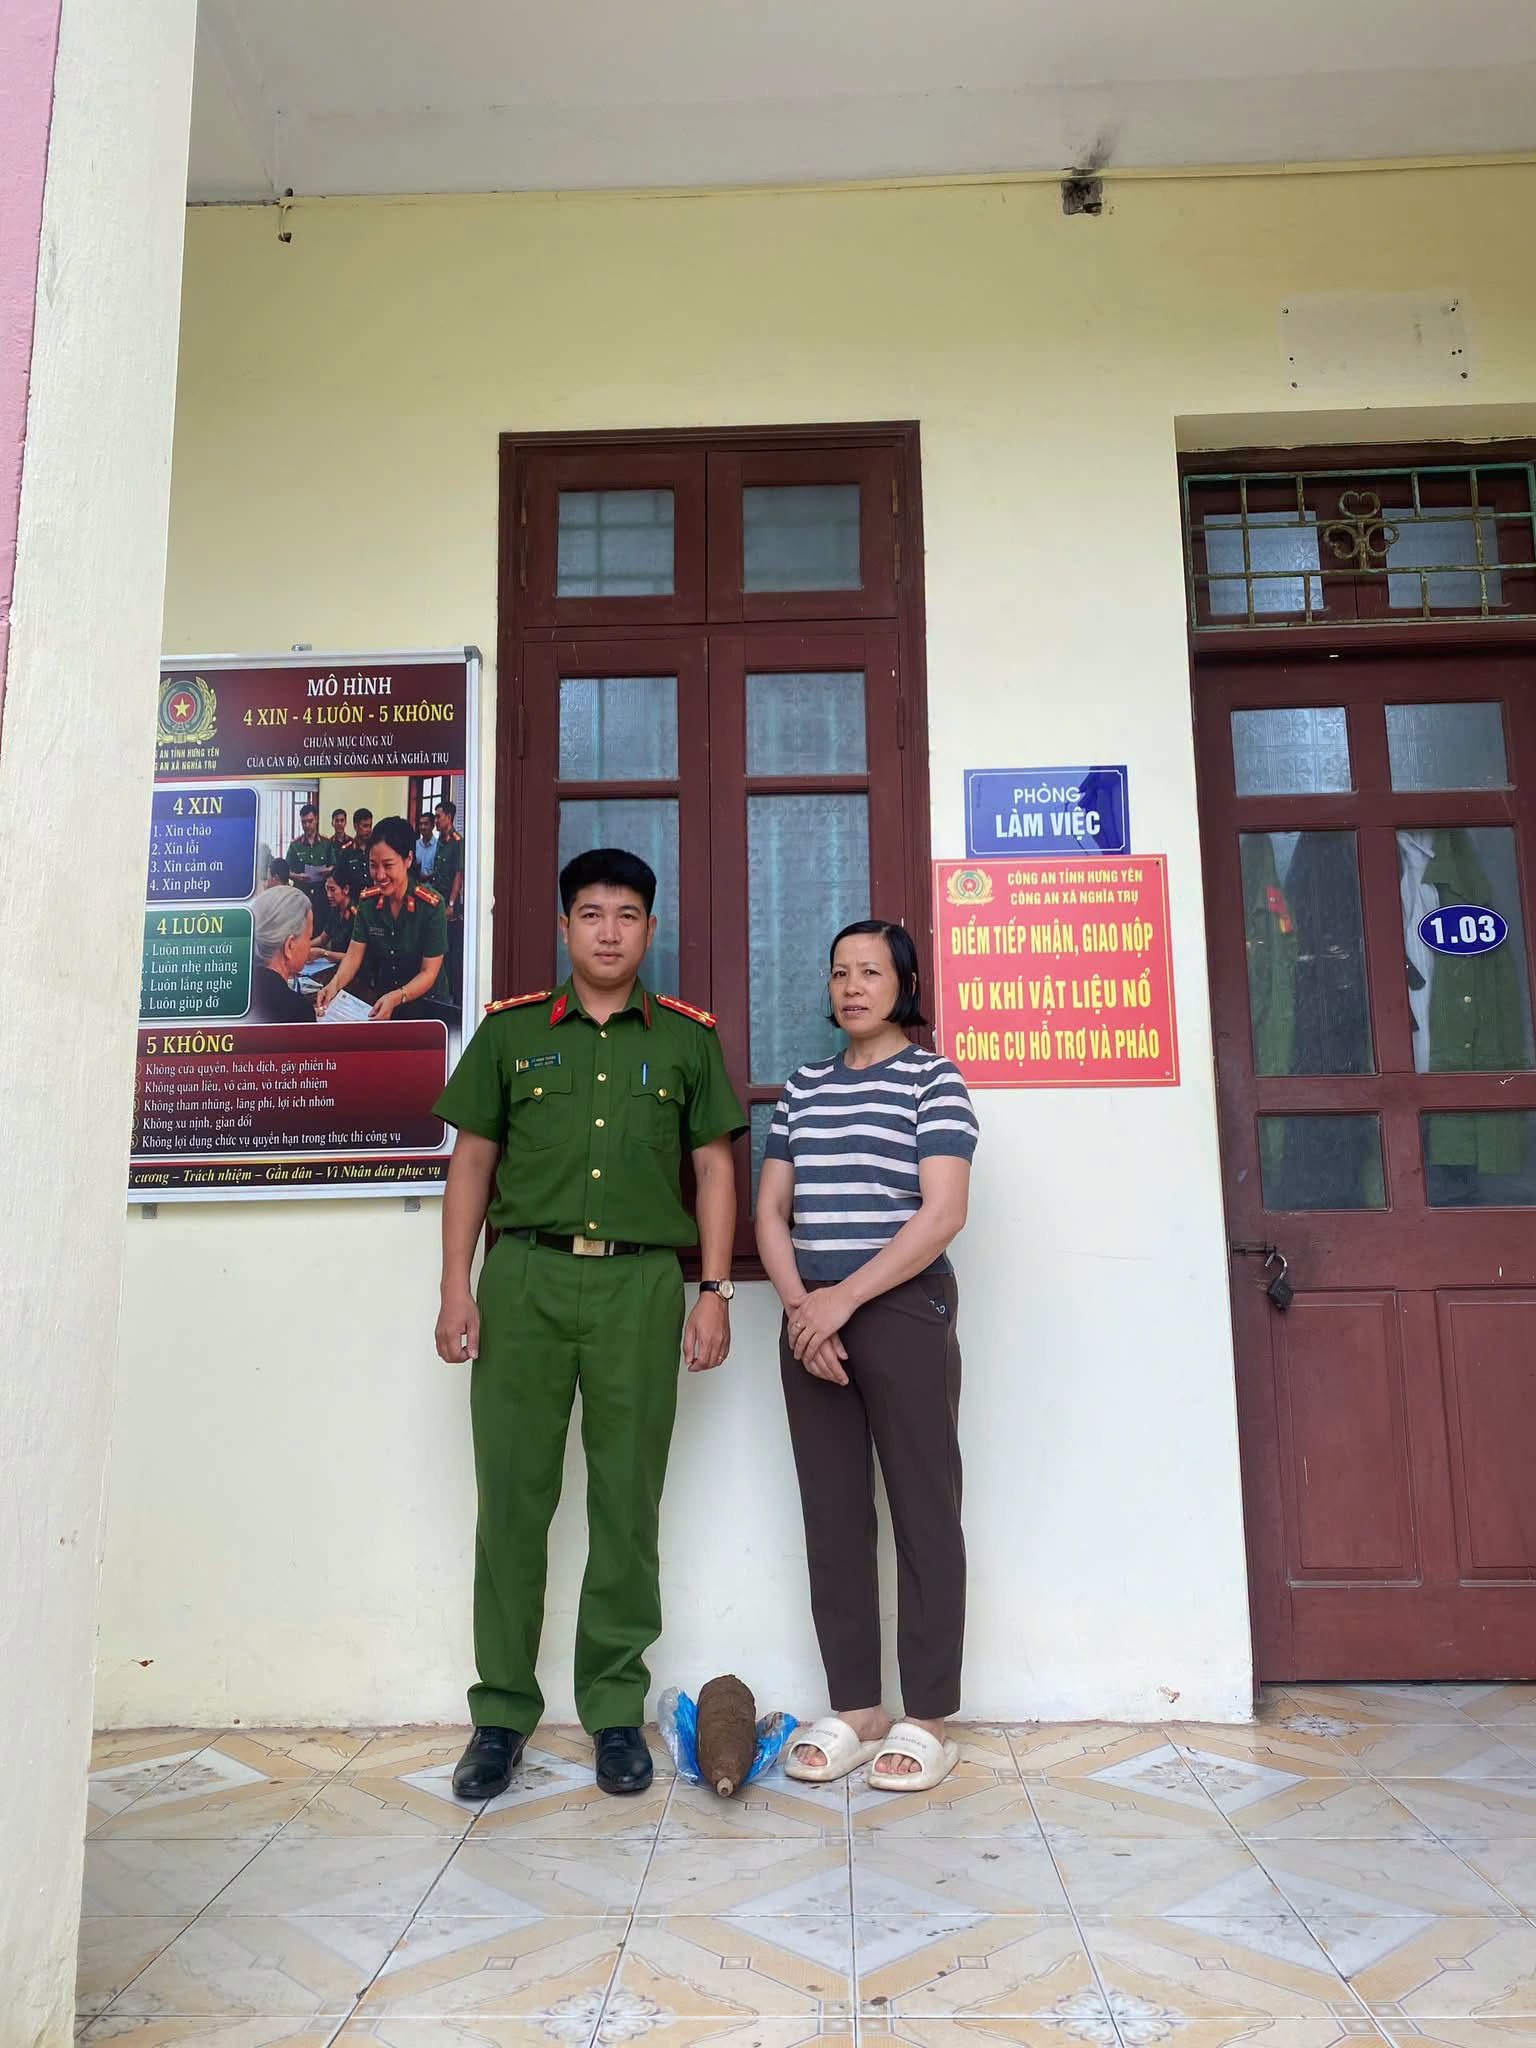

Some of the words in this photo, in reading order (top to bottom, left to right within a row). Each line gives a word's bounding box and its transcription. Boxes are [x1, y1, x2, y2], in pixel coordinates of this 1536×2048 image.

[307, 673, 338, 696] MÔ
[343, 672, 391, 695] HÌNH
[243, 709, 252, 725] 4
[257, 708, 288, 725] XIN
[303, 707, 312, 724] 4
[317, 701, 364, 724] LUÔN
[379, 705, 388, 722] 5
[393, 699, 455, 722] KHÔNG
[344, 751, 369, 765] CÔNG
[371, 754, 384, 765] AN
[431, 752, 449, 765] TRỤ
[1013, 782, 1081, 804] PHÒNG
[173, 798, 183, 815] 4
[188, 796, 223, 815] XIN
[153, 825, 162, 837] 1.
[165, 824, 183, 837] Xin
[186, 823, 212, 836] chào
[995, 808, 1044, 838] LÀM
[1050, 806, 1101, 840] VIỆC
[151, 843, 161, 855] 2.
[164, 842, 182, 855] Xin
[150, 861, 160, 873] 3.
[163, 860, 181, 873] Xin
[209, 860, 223, 871] ơn
[162, 878, 180, 891] Xin
[184, 877, 211, 893] phép
[1007, 870, 1038, 885] CÔNG
[1041, 872, 1056, 884] AN
[1121, 867, 1143, 883] YÊN
[1010, 890, 1041, 905] CÔNG
[1044, 892, 1059, 905] AN
[1062, 889, 1077, 904] XÃ
[1117, 889, 1139, 905] TRỤ
[156, 917, 167, 935] 4
[172, 912, 224, 935] LUÔN
[1430, 915, 1496, 944] 1.03
[951, 914, 990, 956] ĐIỂM
[994, 916, 1027, 955] TIẾP
[1030, 918, 1079, 960] NHẬN,
[1082, 923, 1118, 953] GIAO
[1121, 916, 1154, 958] NỘP
[152, 943, 179, 956] Luôn
[151, 961, 178, 974] Luôn
[181, 960, 201, 975] nhẹ
[204, 959, 238, 975] nhàng
[150, 979, 177, 992] Luôn
[180, 976, 203, 993] lắng
[206, 977, 232, 993] nghe
[958, 976, 984, 1011] VŨ
[989, 975, 1024, 1010] KHÍ
[1028, 975, 1066, 1015] VẬT
[1071, 973, 1117, 1015] LIỆU
[1122, 967, 1151, 1008] NỔ
[149, 997, 176, 1010] Luôn
[179, 996, 203, 1012] giúp
[146, 1036, 157, 1054] 5
[162, 1030, 235, 1054] KHÔNG
[955, 1026, 1001, 1062] CÔNG
[1004, 1031, 1026, 1068] CỤ
[1029, 1020, 1051, 1061] HỖ
[1055, 1027, 1086, 1066] TRỢ
[1089, 1023, 1112, 1060] VÀ
[1115, 1023, 1160, 1059] PHÁO
[145, 1063, 176, 1077] Không
[145, 1081, 175, 1095] Không
[177, 1083, 199, 1095] quan
[224, 1080, 235, 1091] vô
[261, 1079, 273, 1090] vô
[275, 1077, 297, 1089] trách
[300, 1077, 328, 1091] nhiệm
[144, 1099, 174, 1113] Không
[176, 1098, 199, 1111] tham
[236, 1097, 256, 1111] lãng
[278, 1096, 289, 1110] lợi
[292, 1095, 306, 1107] ích
[308, 1095, 335, 1108] nhóm
[143, 1117, 173, 1131] Không
[175, 1119, 186, 1129] xu
[215, 1115, 235, 1131] gian
[142, 1135, 172, 1150] Không
[174, 1135, 187, 1149] lợi
[189, 1134, 213, 1149] dụng
[215, 1133, 237, 1146] chức
[239, 1136, 250, 1148] vụ
[252, 1131, 280, 1148] quyền
[282, 1132, 299, 1146] hạn
[301, 1133, 326, 1145] trong
[328, 1130, 348, 1145] thực
[350, 1130, 363, 1142] thi
[365, 1129, 388, 1144] công
[390, 1131, 401, 1145] vụ
[135, 1172, 170, 1185] cương
[183, 1168, 215, 1182] Trách
[217, 1168, 252, 1183] nhiệm
[265, 1164, 289, 1180] Gần
[291, 1166, 312, 1179] dân
[341, 1164, 372, 1178] Nhân
[374, 1164, 395, 1177] dân
[397, 1163, 425, 1179] phục
[428, 1166, 441, 1179] vụ
